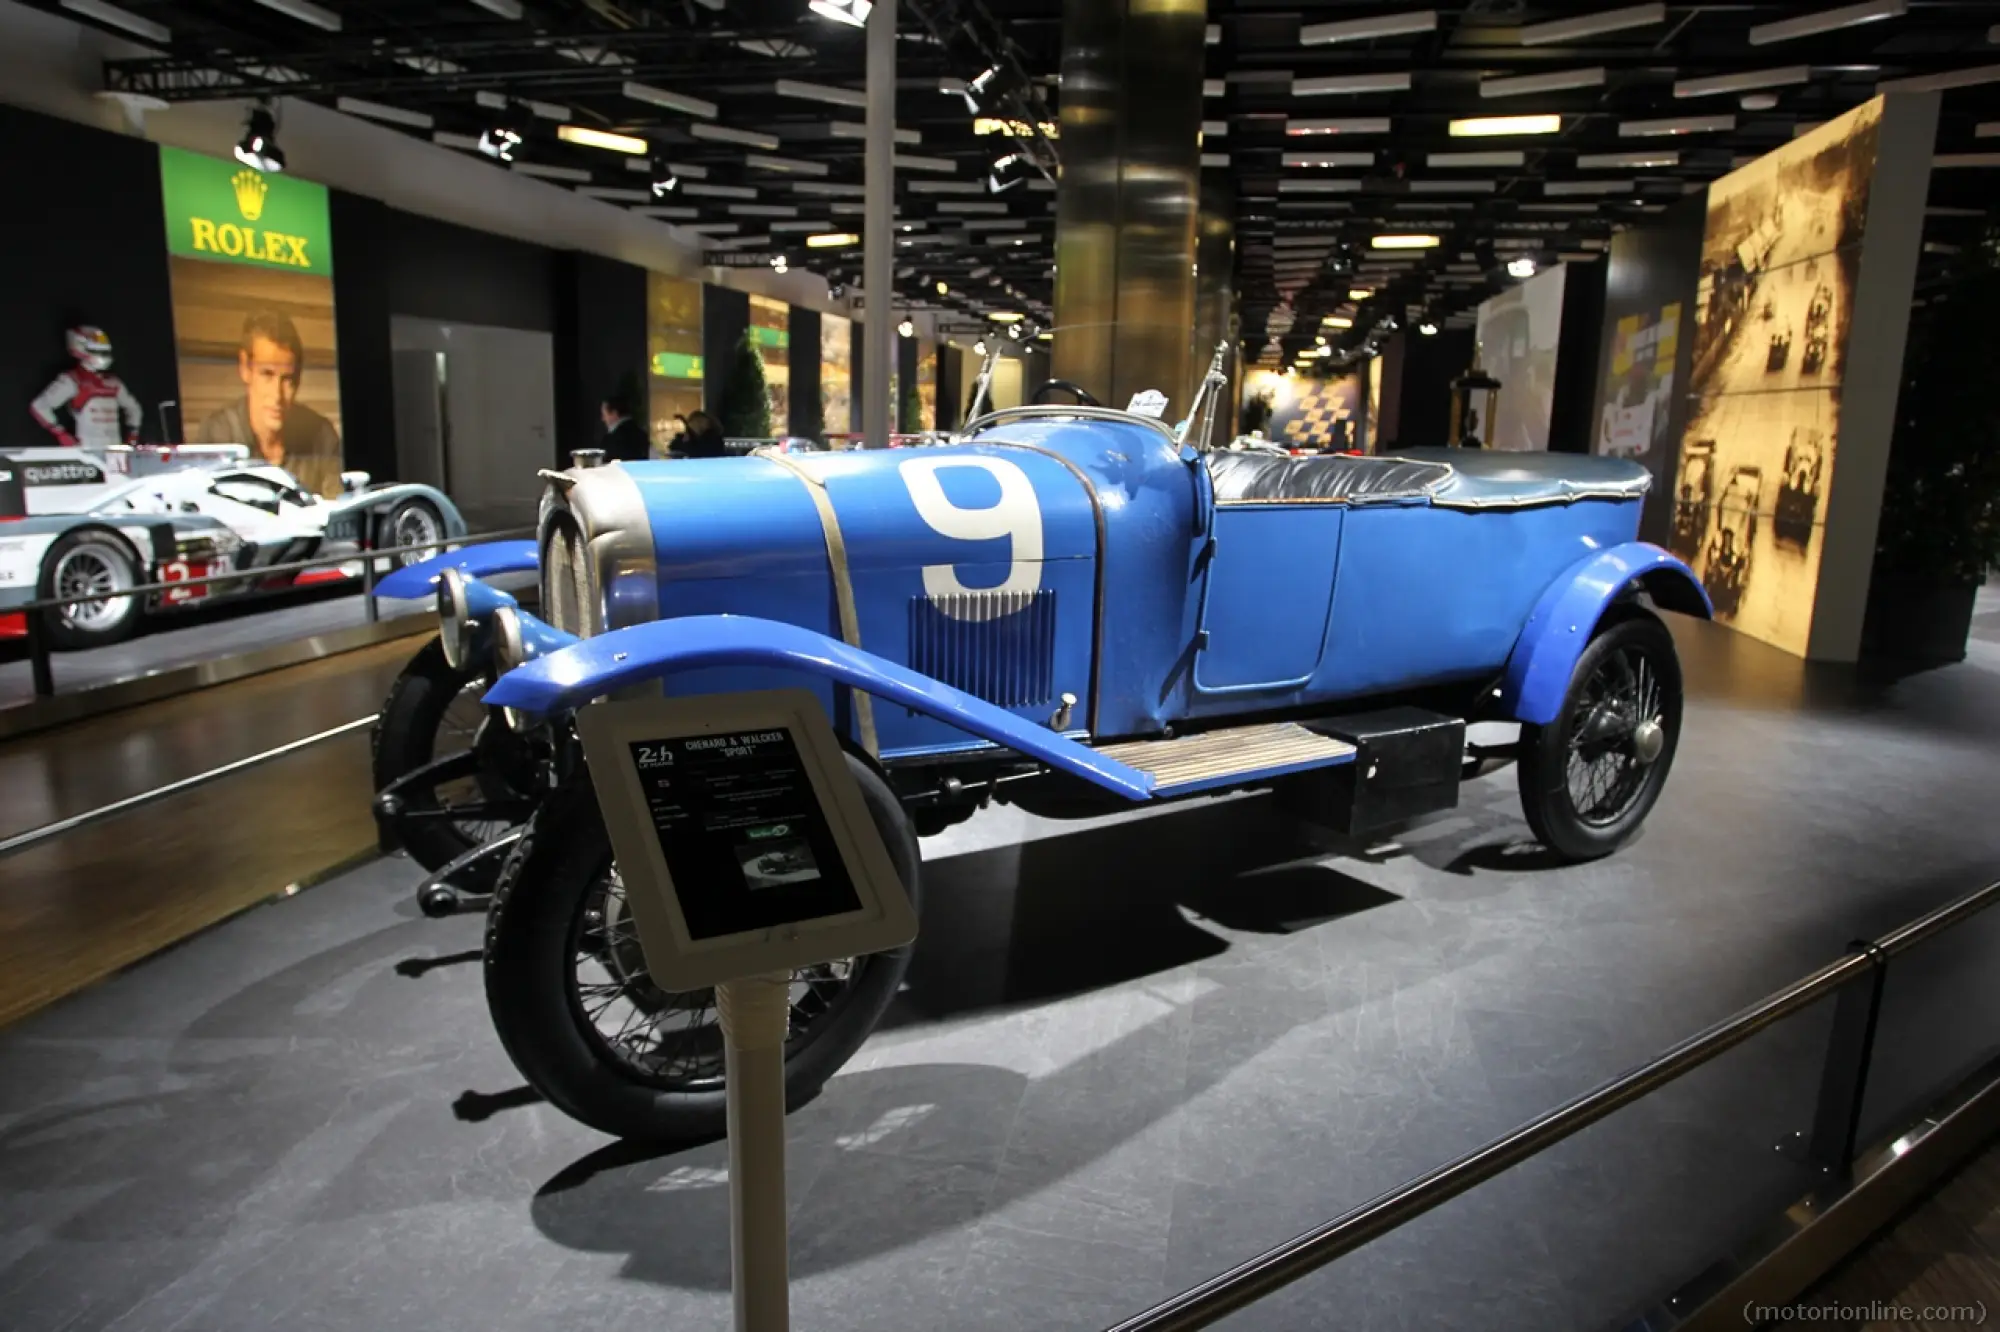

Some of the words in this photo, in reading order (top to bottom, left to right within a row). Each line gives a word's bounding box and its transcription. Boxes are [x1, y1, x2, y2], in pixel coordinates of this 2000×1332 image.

[190, 217, 311, 267] ROLEX
[24, 464, 98, 483] quattro
[898, 454, 1044, 622] 9
[740, 732, 784, 744] WALCKER
